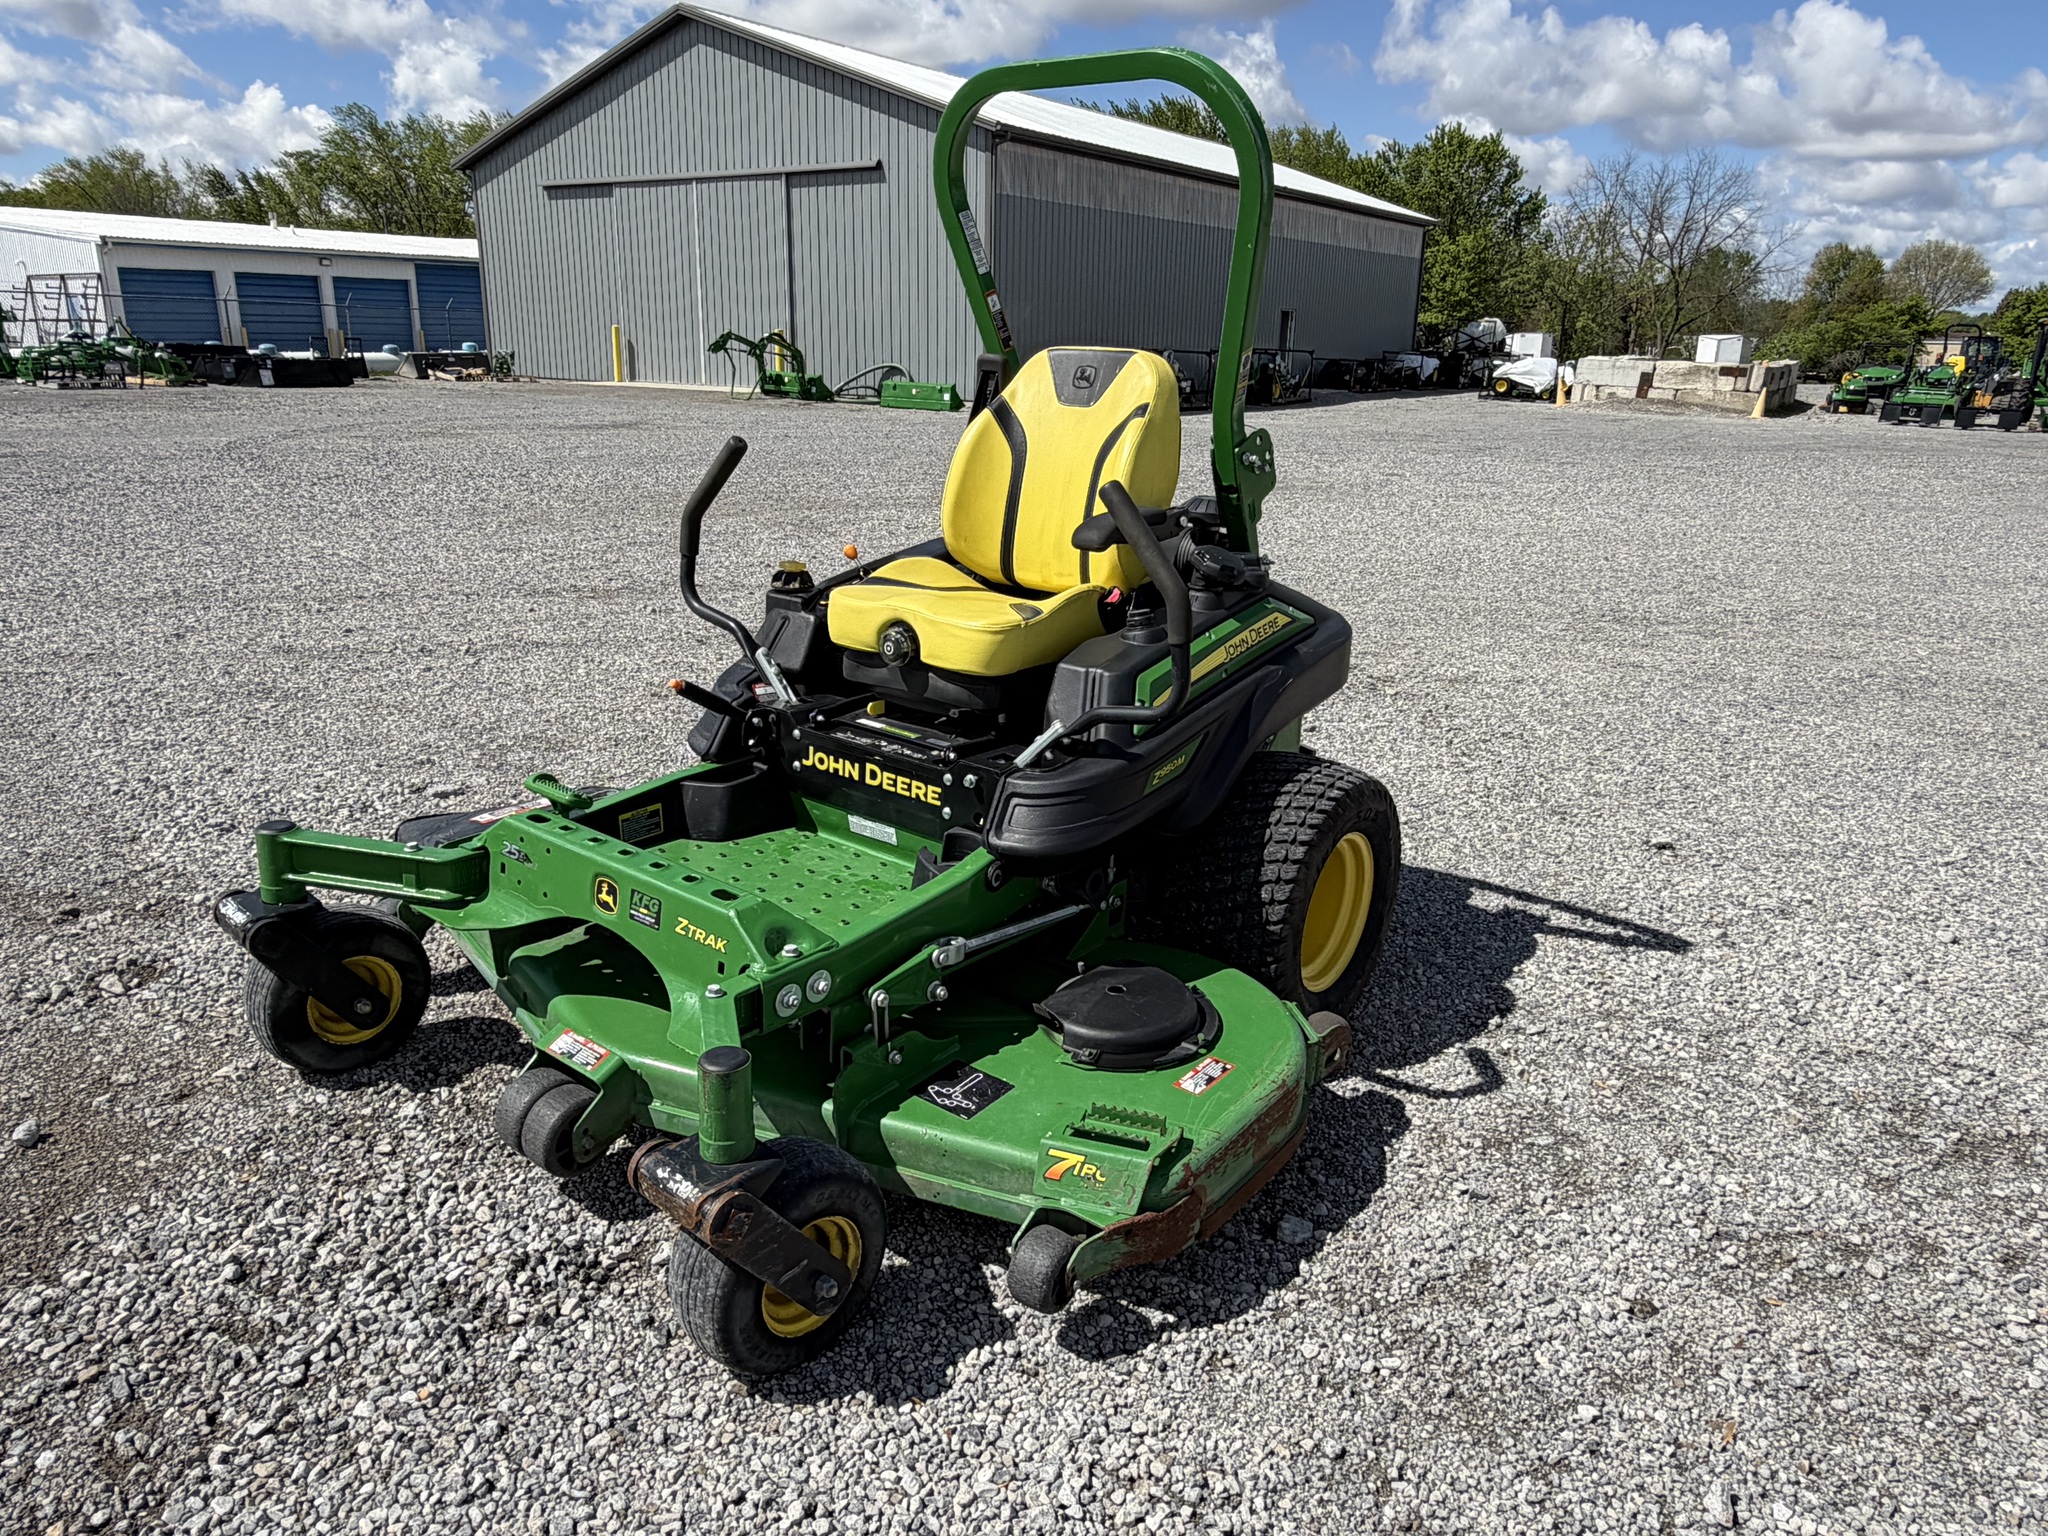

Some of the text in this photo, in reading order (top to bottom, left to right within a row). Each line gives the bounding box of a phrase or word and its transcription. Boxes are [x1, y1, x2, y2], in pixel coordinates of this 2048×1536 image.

[1223, 617, 1280, 661] JOHN DEERE
[802, 745, 860, 781] JOHN
[865, 762, 942, 807] DEERE
[632, 891, 660, 913] KFG
[674, 916, 728, 954] ZTRAK
